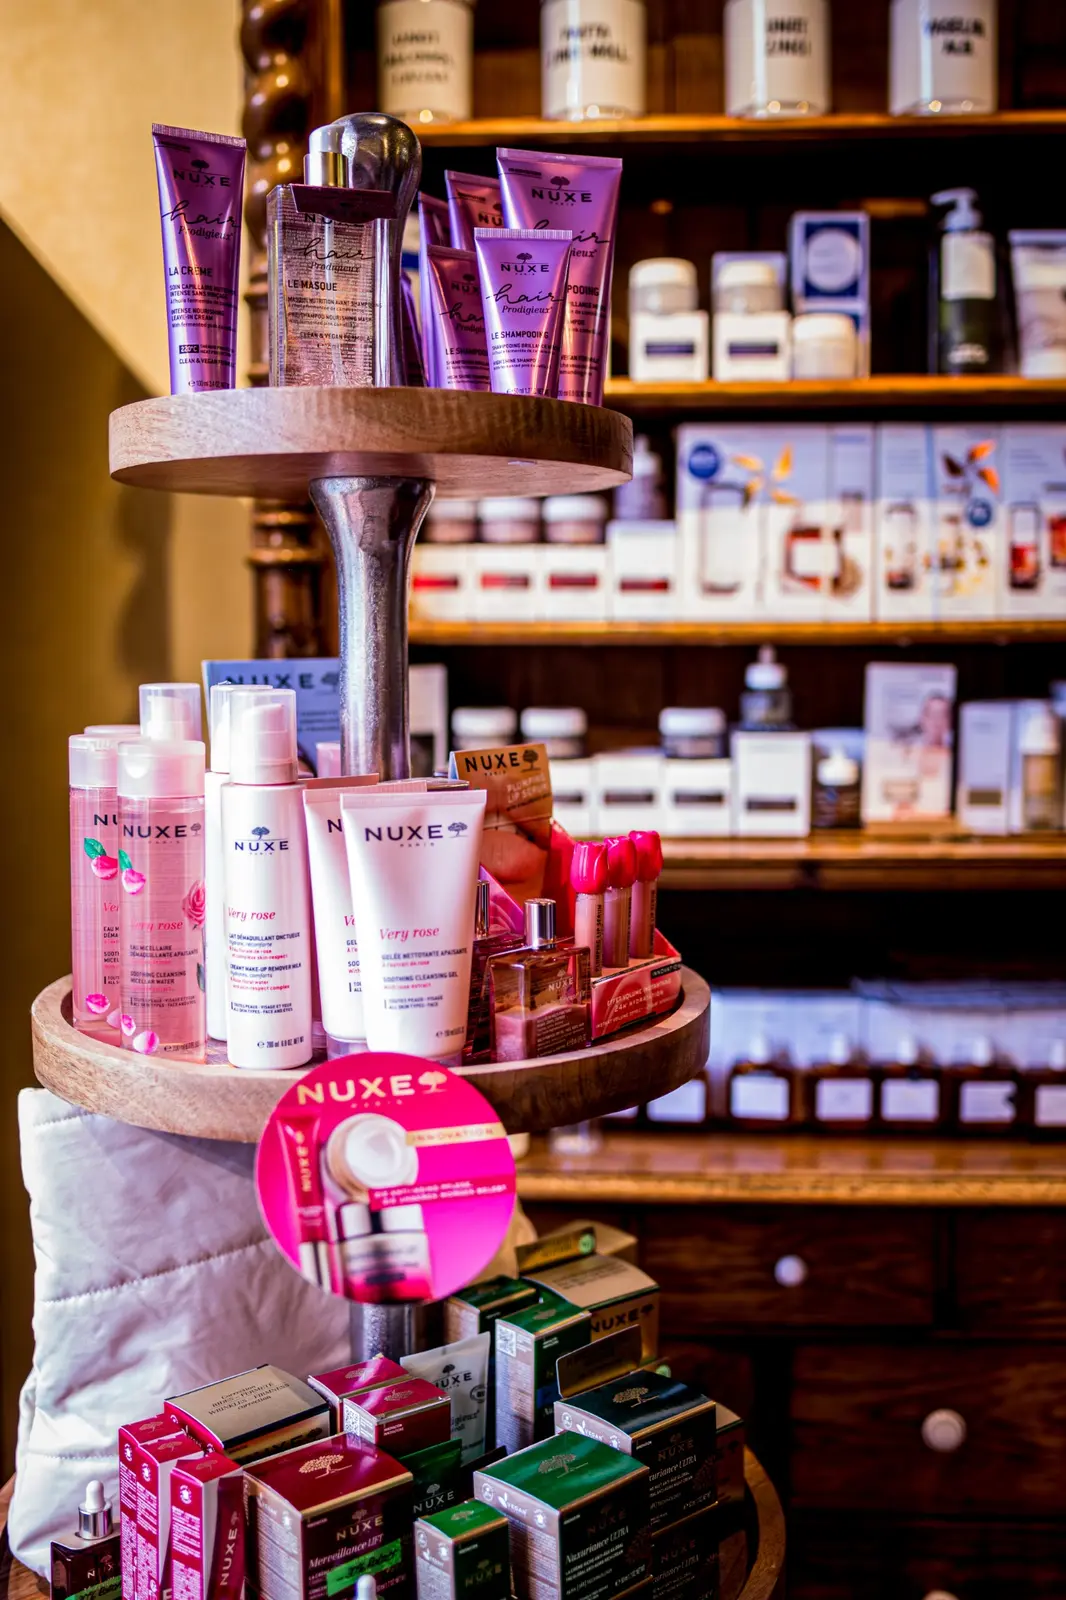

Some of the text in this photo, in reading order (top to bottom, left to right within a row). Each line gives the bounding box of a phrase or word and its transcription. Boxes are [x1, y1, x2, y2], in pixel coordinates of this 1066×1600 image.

[173, 168, 231, 187] NUXE
[531, 188, 593, 203] NUXE
[161, 200, 240, 228] hair
[292, 237, 376, 260] hair
[168, 266, 179, 276] LA
[500, 263, 549, 273] NUXE
[287, 280, 338, 292] LE MASQUE
[450, 282, 481, 296] NUX
[567, 284, 600, 297] POOING
[485, 283, 565, 305] hair
[439, 301, 485, 323] ha
[501, 305, 553, 315] Prodigieux
[491, 330, 549, 341] LE SHAMPOOING
[445, 347, 454, 356] LE
[465, 751, 521, 773] NUXE
[123, 825, 188, 839] NUXE
[364, 824, 444, 842] NUXE
[234, 840, 289, 851] NUXE
[228, 907, 276, 922] Very rose
[157, 920, 183, 931] rose
[379, 927, 440, 942] Very rose
[440, 947, 468, 957] APAISANTE
[155, 970, 187, 978] CLEANSING
[267, 964, 292, 972] REMOVER
[414, 972, 448, 982] CLEANSING
[448, 971, 459, 979] GEL
[548, 976, 574, 992] NUXE
[296, 1074, 416, 1106] NUXE
[589, 1307, 640, 1334] NUXE
[436, 1371, 472, 1388] UXE
[657, 1438, 696, 1462] NUXE
[413, 1490, 456, 1514] NUXE
[335, 1515, 385, 1542] NUXE
[219, 1527, 239, 1586] NUXE
[308, 1540, 368, 1571] Merveillance
[564, 1536, 610, 1565] Nuxuriance
[464, 1562, 503, 1589] NUXE
